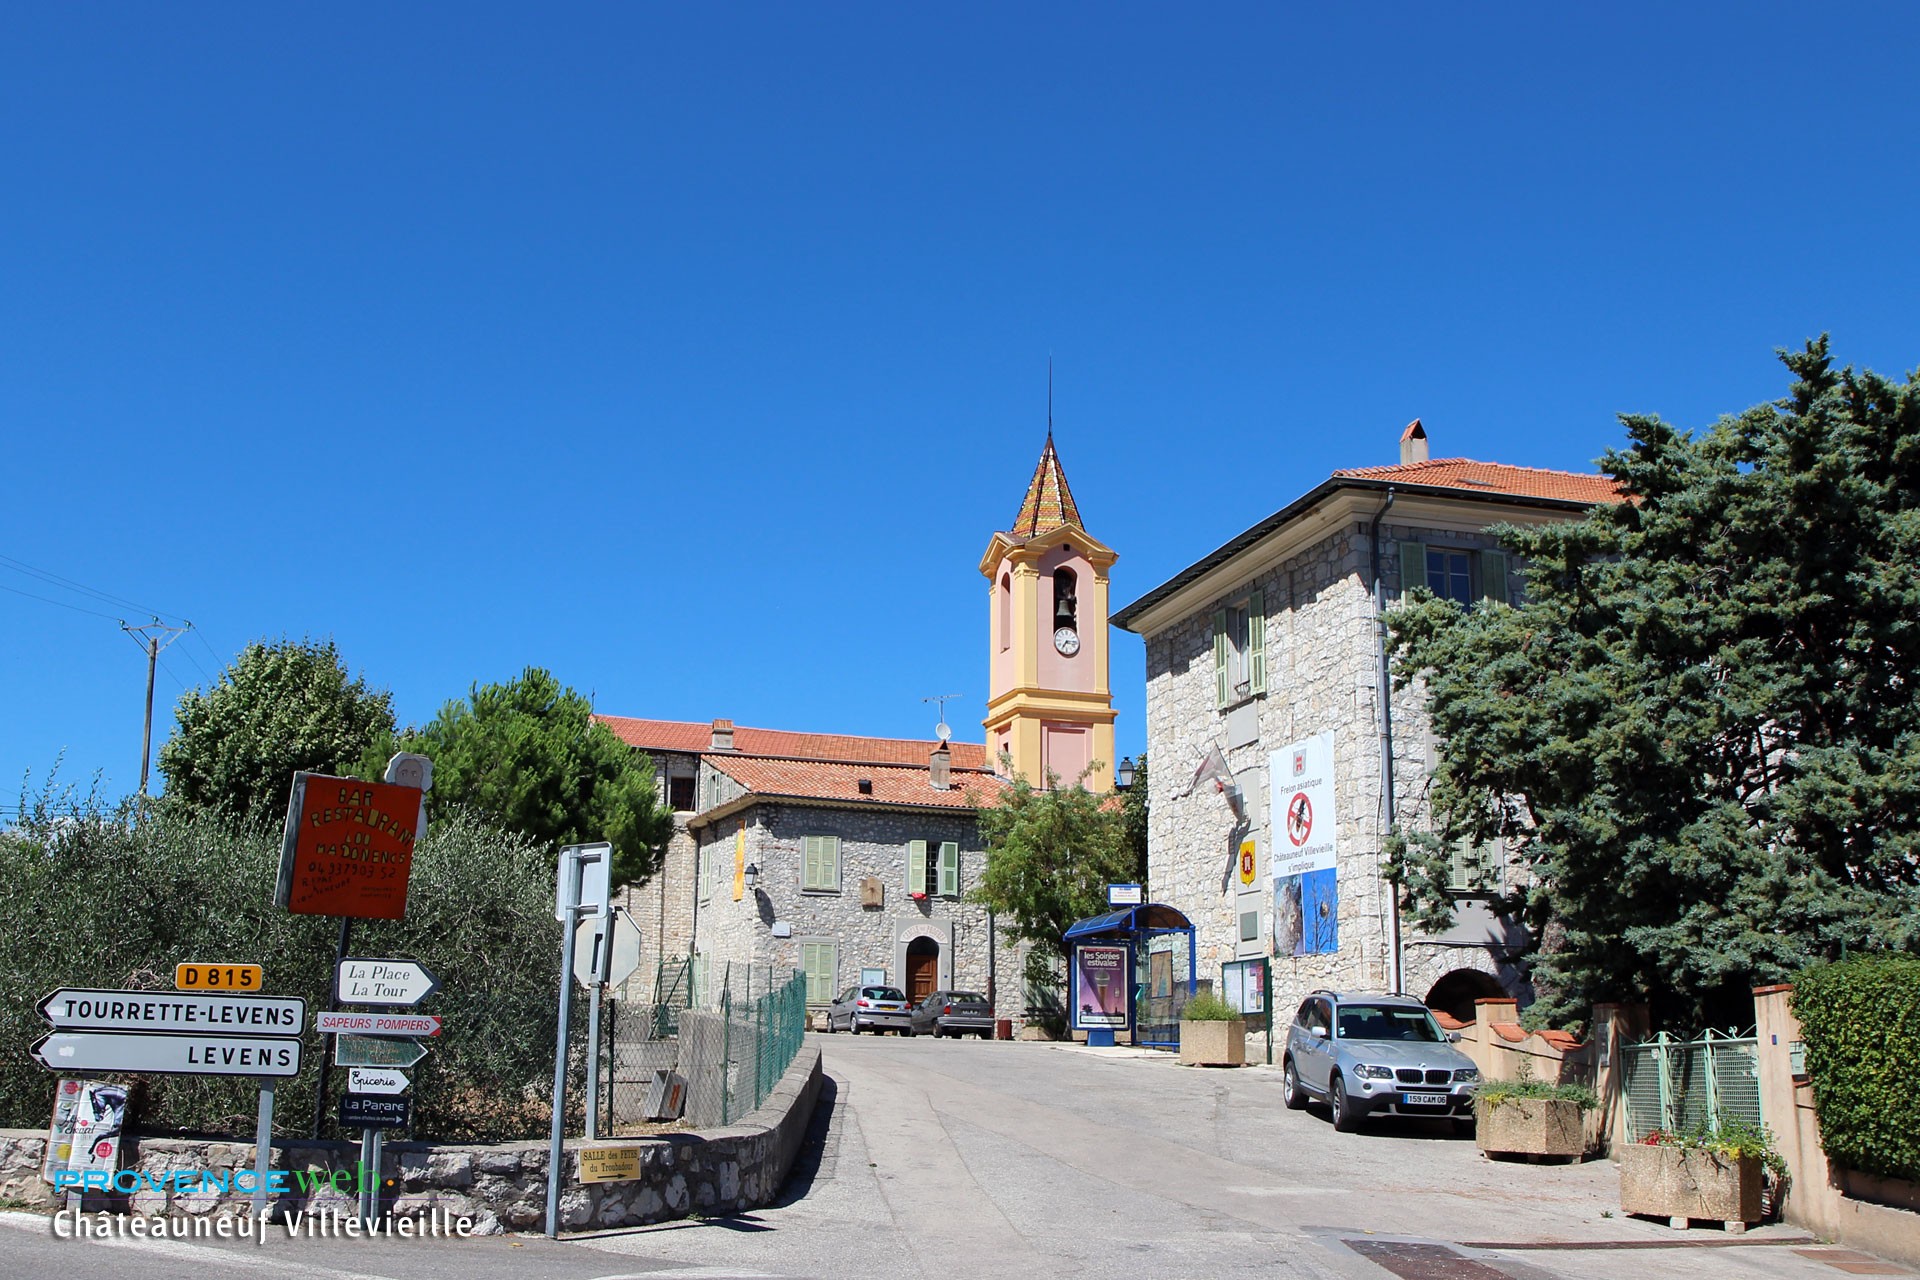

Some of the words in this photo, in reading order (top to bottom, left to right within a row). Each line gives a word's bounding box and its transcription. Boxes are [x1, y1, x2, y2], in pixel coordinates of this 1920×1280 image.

[1281, 785, 1296, 795] Frelon
[1297, 778, 1322, 789] asiatique
[339, 787, 373, 806] BAR
[311, 807, 416, 847] RESTAURANT
[344, 832, 371, 846] LOU
[1304, 843, 1333, 855] Villevieille
[1084, 952, 1094, 960] les
[1095, 952, 1120, 960] Soirées
[186, 969, 198, 985] D
[207, 968, 253, 987] 815
[349, 965, 365, 979] La
[372, 966, 411, 980] Place
[351, 983, 368, 996] La
[374, 984, 408, 997] Tour
[65, 1000, 295, 1026] TOURRETTE-LEVENS
[322, 1017, 372, 1029] SAPEURS
[376, 1019, 431, 1031] POMPIERS
[188, 1046, 291, 1067] LEVENS
[344, 1099, 359, 1110] La
[362, 1099, 404, 1112] Parare
[1409, 1095, 1422, 1103] 159
[1423, 1096, 1436, 1104] CAM
[1437, 1096, 1446, 1104] 06
[584, 1151, 605, 1160] SALLE
[608, 1151, 617, 1159] des
[590, 1164, 598, 1172] du
[601, 1162, 633, 1171] Troubadour
